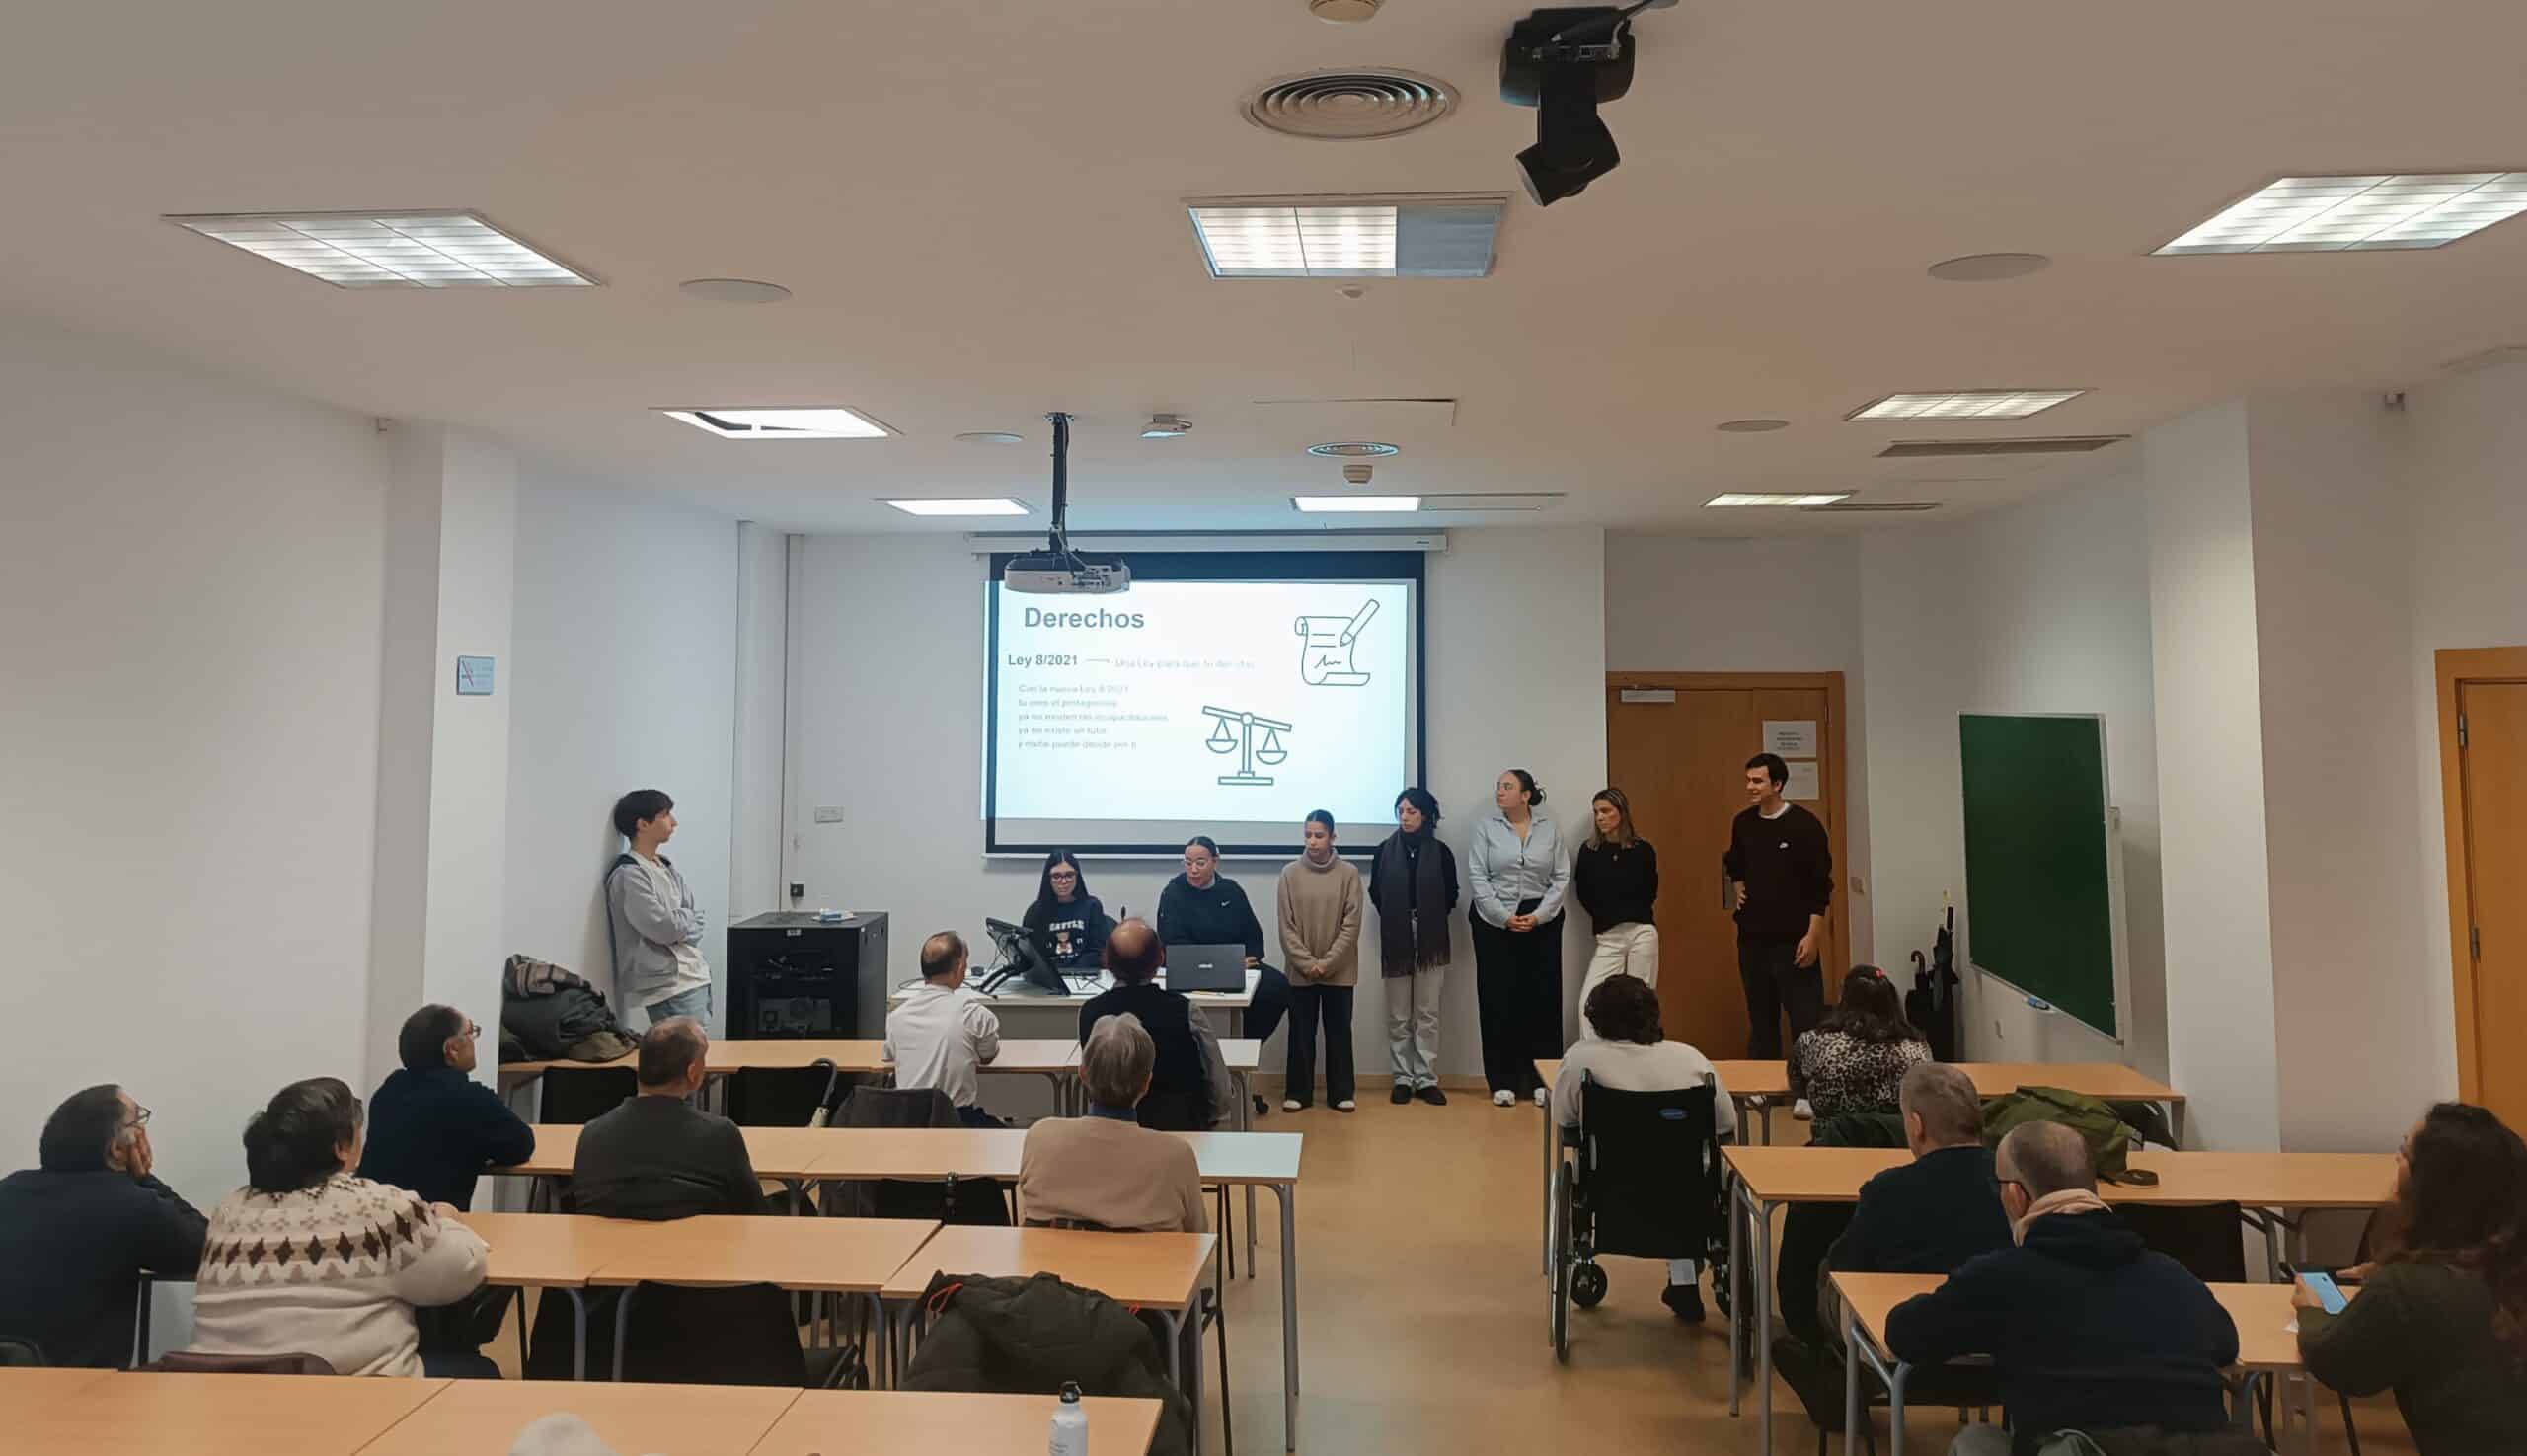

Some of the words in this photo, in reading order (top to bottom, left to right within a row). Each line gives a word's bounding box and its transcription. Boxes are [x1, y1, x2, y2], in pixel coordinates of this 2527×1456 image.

[1025, 607, 1144, 629] Derechos
[1008, 654, 1032, 668] Ley
[1035, 654, 1077, 665] 8/2021
